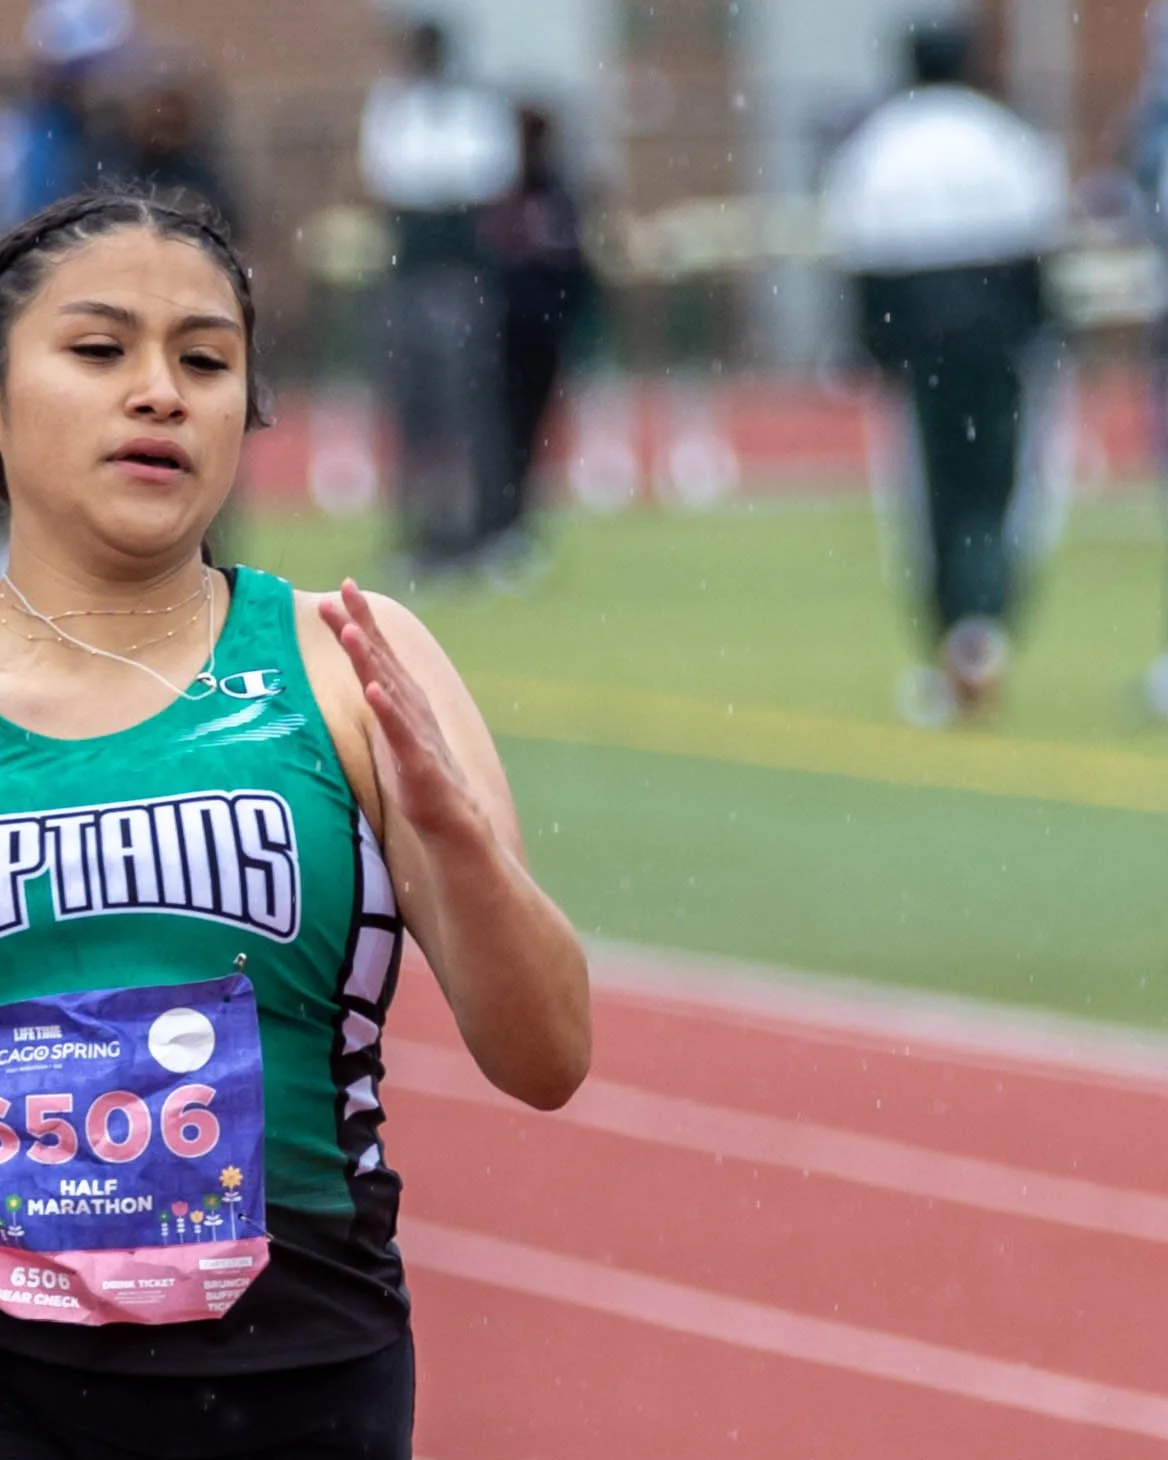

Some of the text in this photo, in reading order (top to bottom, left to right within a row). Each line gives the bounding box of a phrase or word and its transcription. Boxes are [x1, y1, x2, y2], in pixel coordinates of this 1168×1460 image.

[50, 1041, 120, 1060] SPRING
[60, 1179, 118, 1196] HALF
[27, 1196, 153, 1215] MARATHON
[10, 1266, 70, 1290] 6506
[138, 1278, 176, 1288] TICKET
[33, 1293, 80, 1308] CHECK
